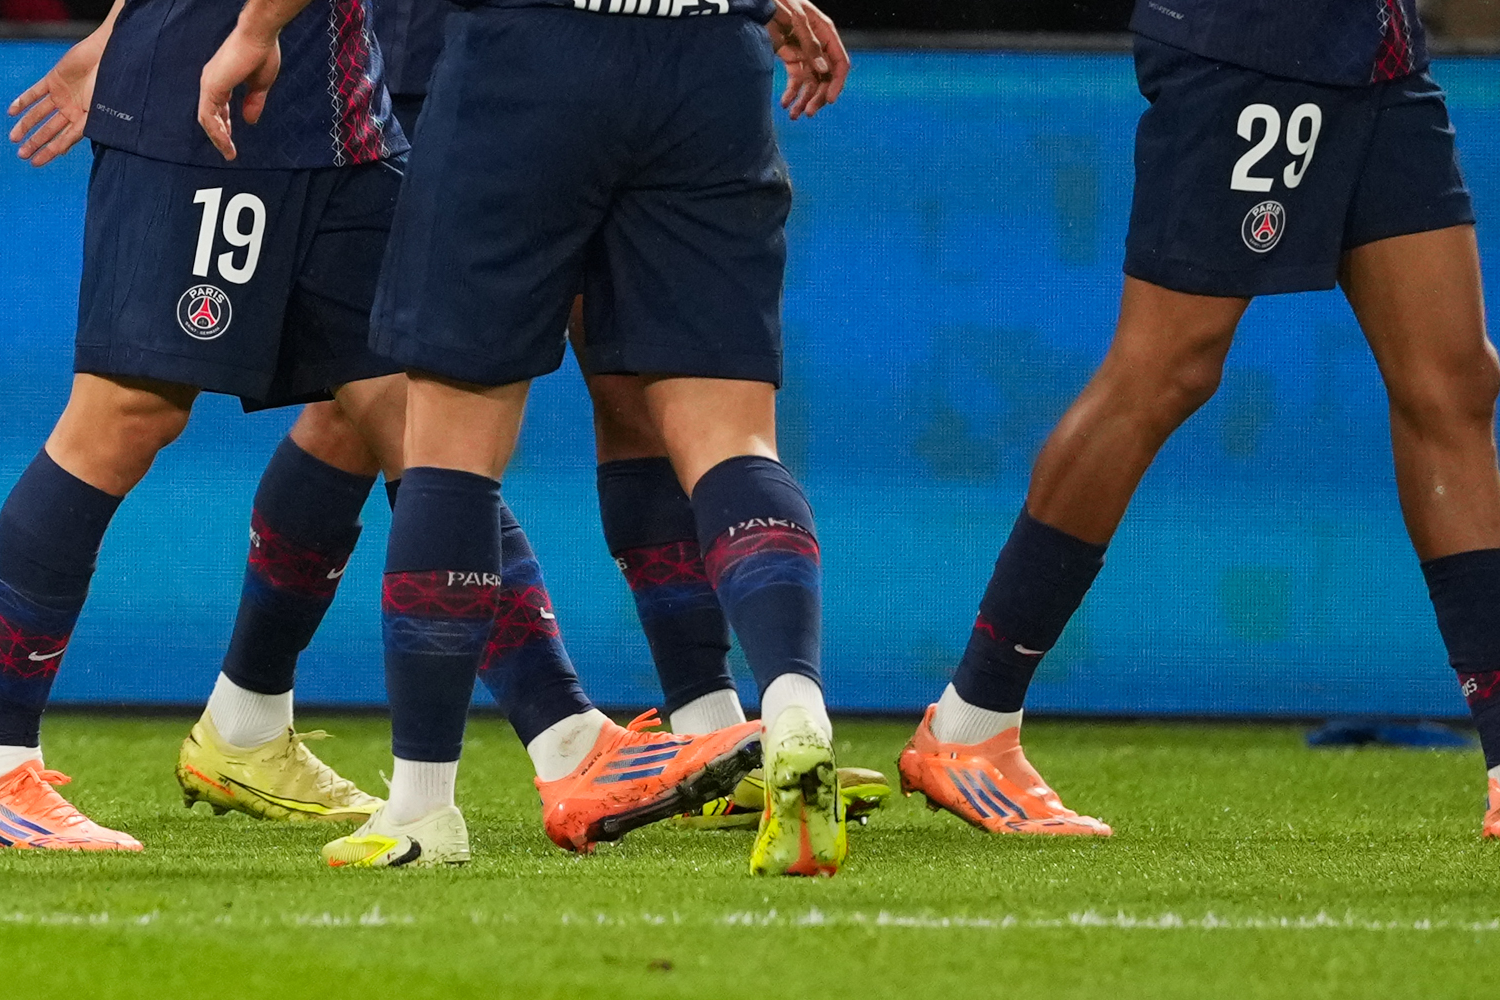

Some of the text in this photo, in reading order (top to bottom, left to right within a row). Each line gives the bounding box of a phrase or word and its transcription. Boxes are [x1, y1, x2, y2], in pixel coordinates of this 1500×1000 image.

[1230, 103, 1322, 192] 29
[192, 187, 267, 284] 19
[1251, 203, 1281, 217] PARIS
[188, 287, 225, 303] PARIS
